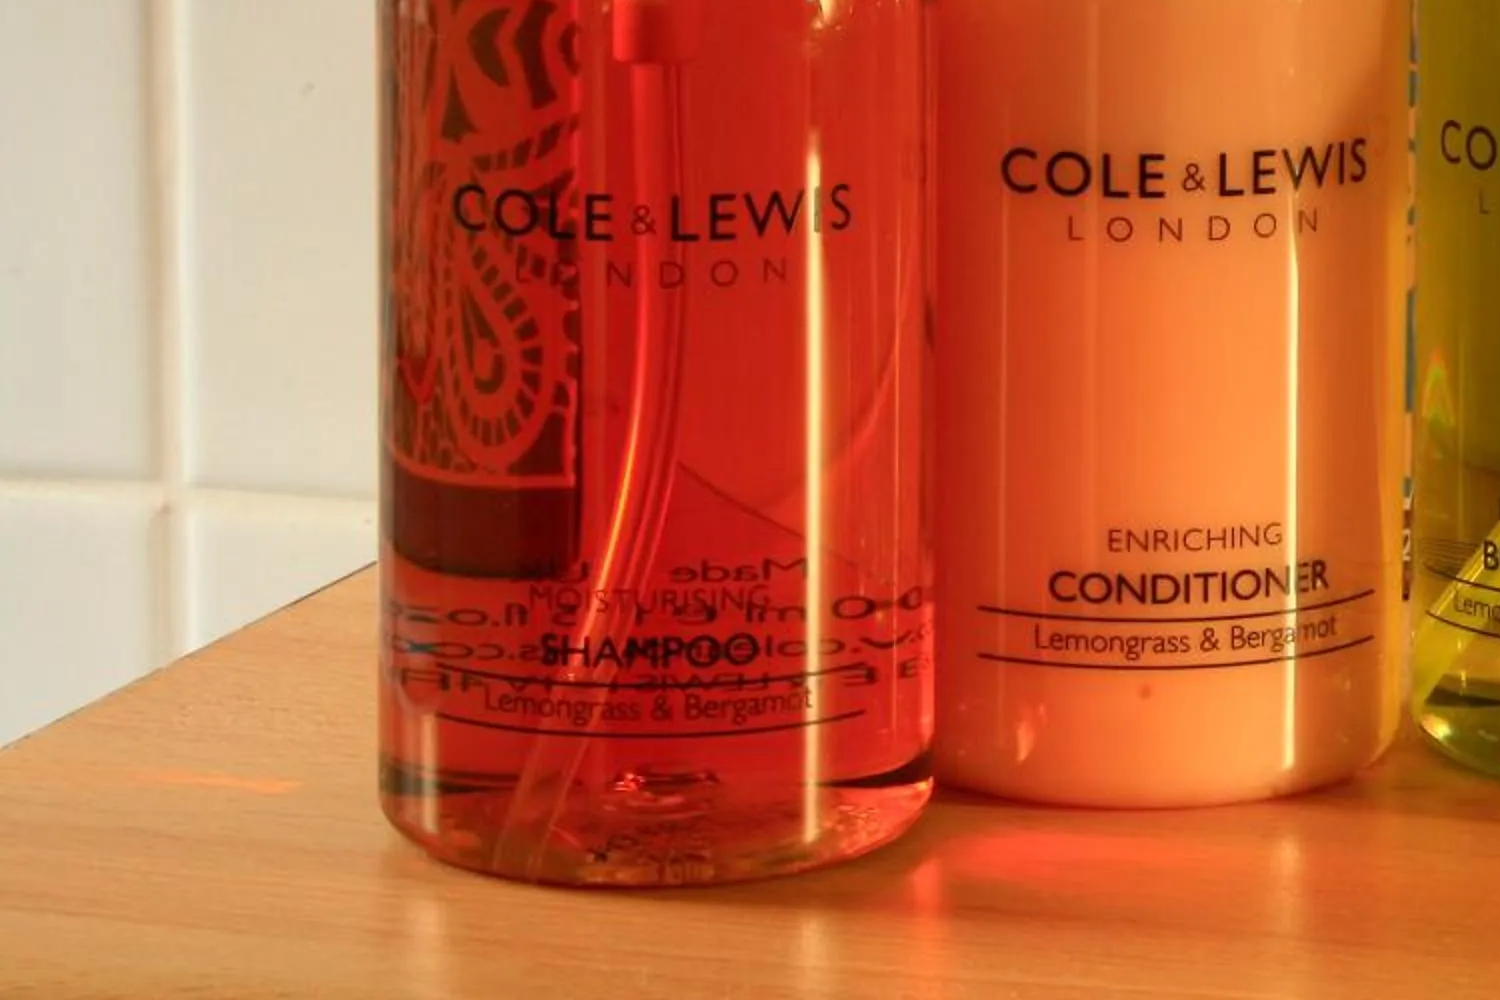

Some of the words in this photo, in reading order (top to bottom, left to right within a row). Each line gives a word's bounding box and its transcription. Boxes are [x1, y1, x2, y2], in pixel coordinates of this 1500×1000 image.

[1002, 147, 1166, 199] COLE
[1182, 162, 1205, 192] &
[1218, 138, 1367, 198] LEWIS
[452, 184, 614, 241] COLE
[630, 205, 657, 235] &
[671, 184, 852, 241] LEWIS
[1068, 209, 1319, 243] LONDON
[1108, 522, 1282, 553] ENRICHING
[529, 584, 769, 614] MOISTURISING
[1048, 560, 1329, 605] CONDITIONER
[540, 632, 757, 669] SHAMPOO
[1034, 624, 1190, 661] Lemongrass
[1200, 628, 1221, 652] &
[1230, 614, 1337, 654] Bergamot
[484, 684, 638, 727] Lemongrass
[649, 697, 673, 721] &
[684, 686, 814, 725] Bergamot
